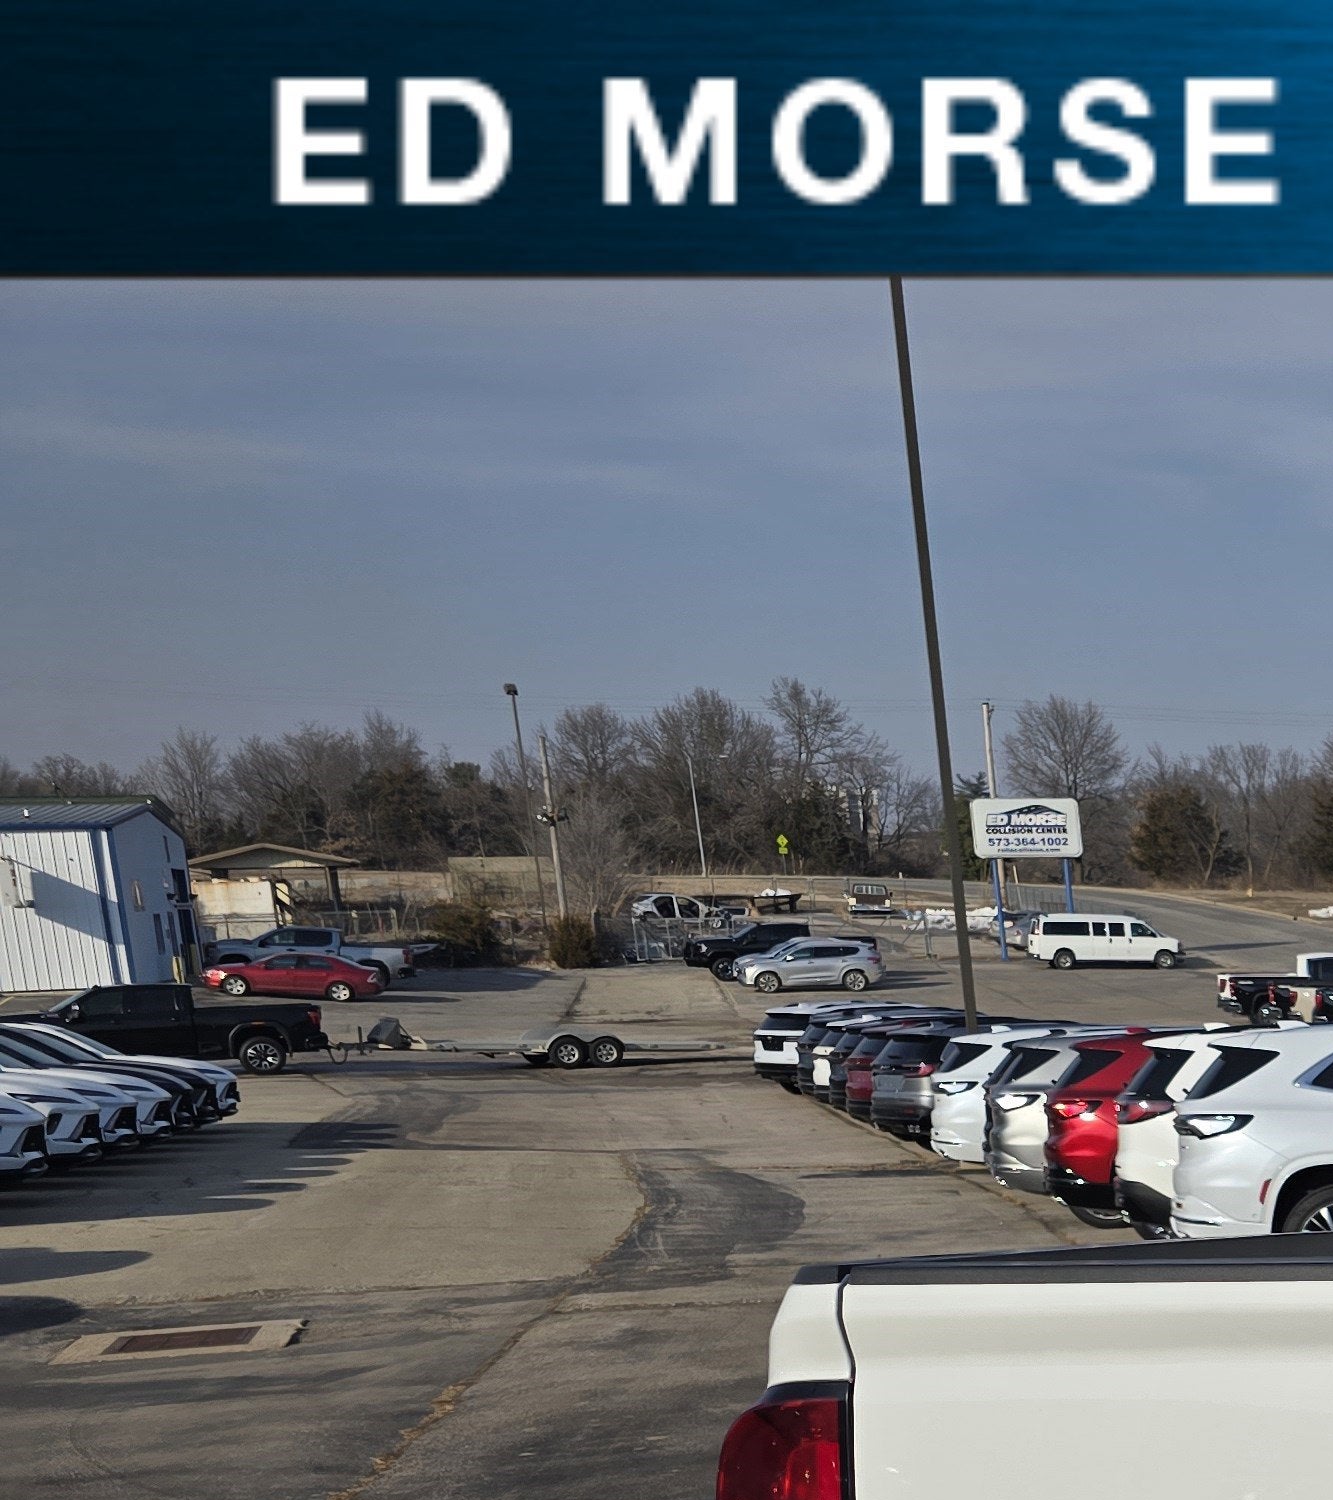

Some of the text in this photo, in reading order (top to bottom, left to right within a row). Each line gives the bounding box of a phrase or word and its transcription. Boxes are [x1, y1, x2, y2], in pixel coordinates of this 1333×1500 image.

[986, 812, 1067, 826] ED MORSE
[985, 826, 1068, 834] COLLISION CENTER
